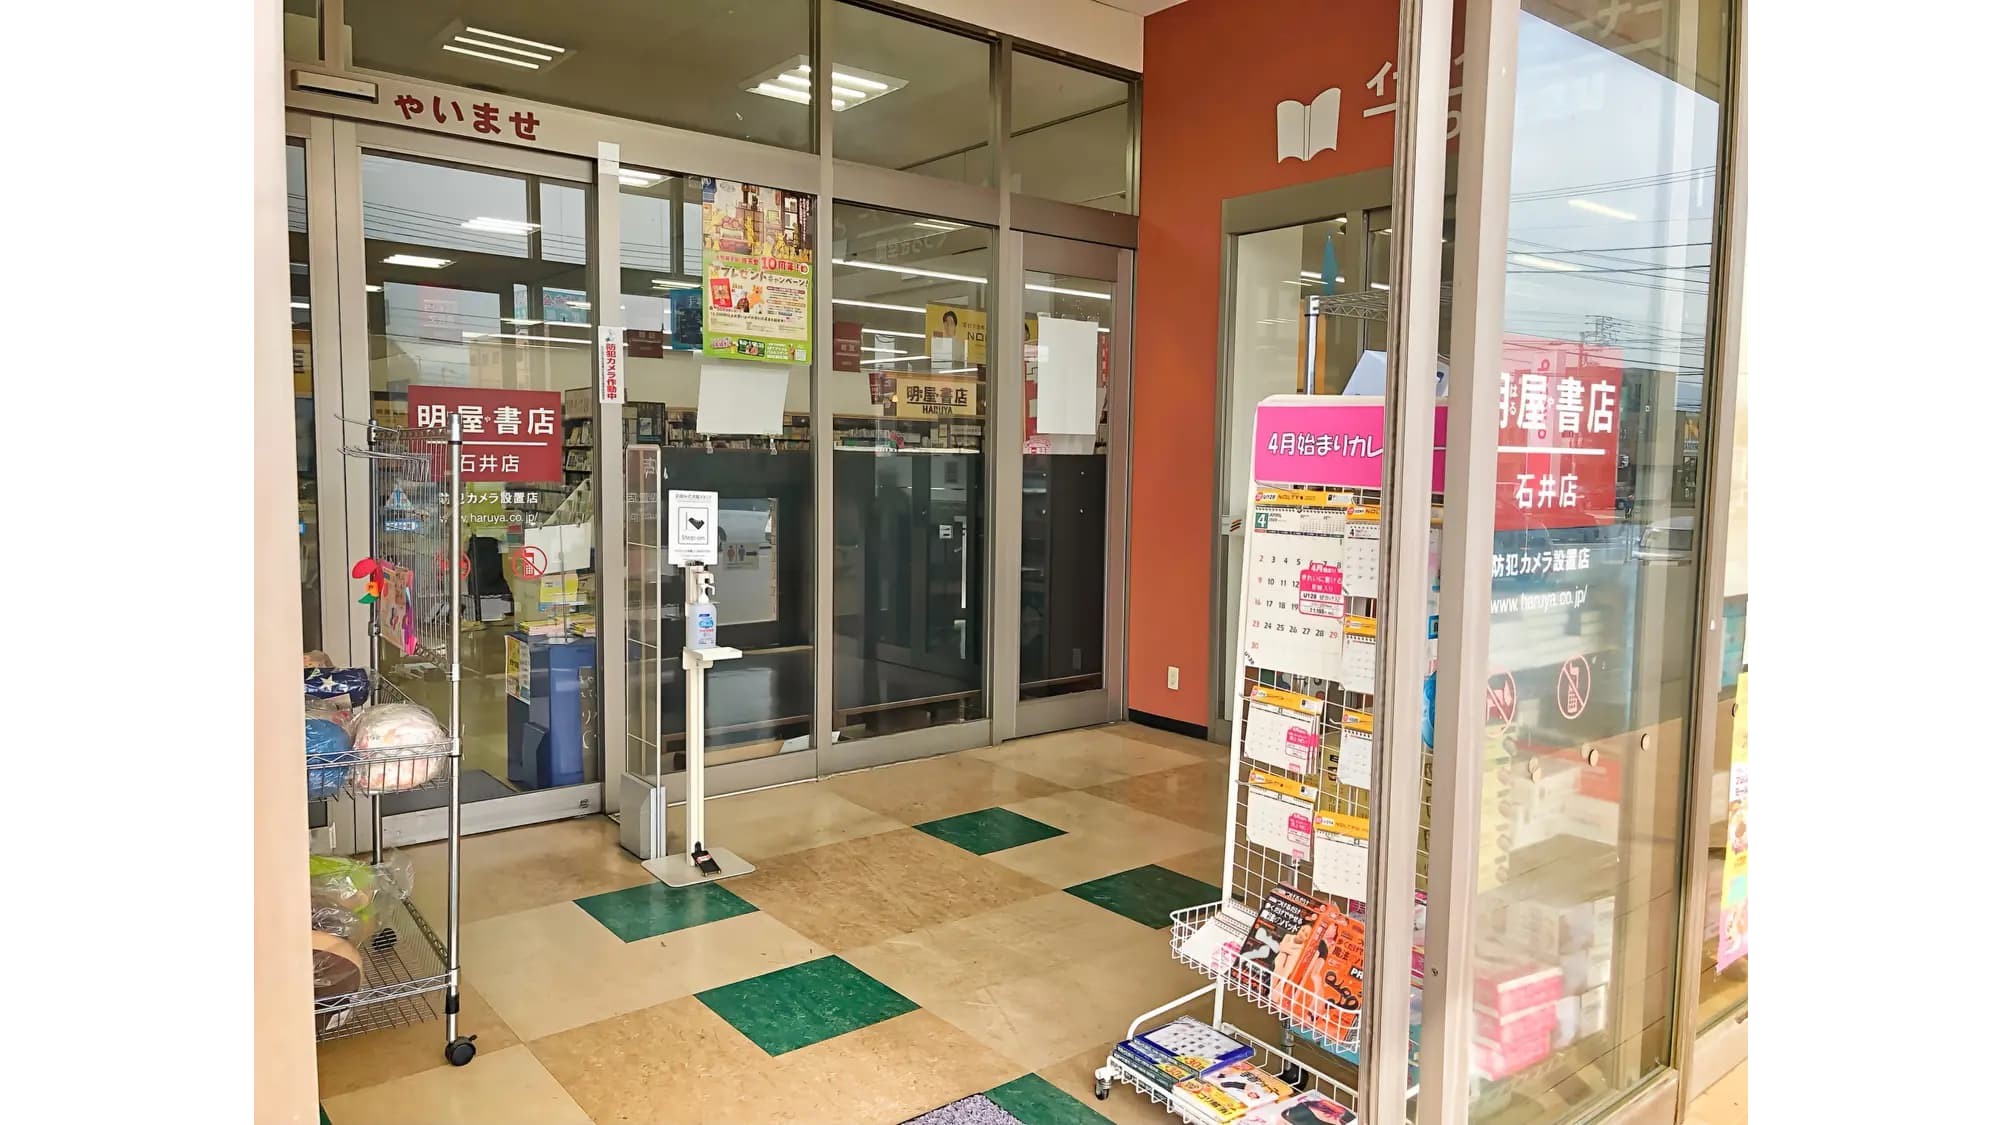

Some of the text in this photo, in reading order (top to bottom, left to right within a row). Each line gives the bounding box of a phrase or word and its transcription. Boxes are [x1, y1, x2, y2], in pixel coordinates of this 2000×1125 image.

[605, 343, 617, 400] 防犯カメラ作動中
[460, 454, 520, 474] 石井店
[1516, 473, 1579, 509] 石井店
[1257, 513, 1267, 528] 4
[1491, 547, 1591, 578] 防犯カメラ設置店
[1276, 623, 1284, 631] 25
[1289, 625, 1297, 633] 26
[1302, 627, 1310, 635] 27
[1315, 629, 1324, 637] 28
[1329, 631, 1337, 639] 29
